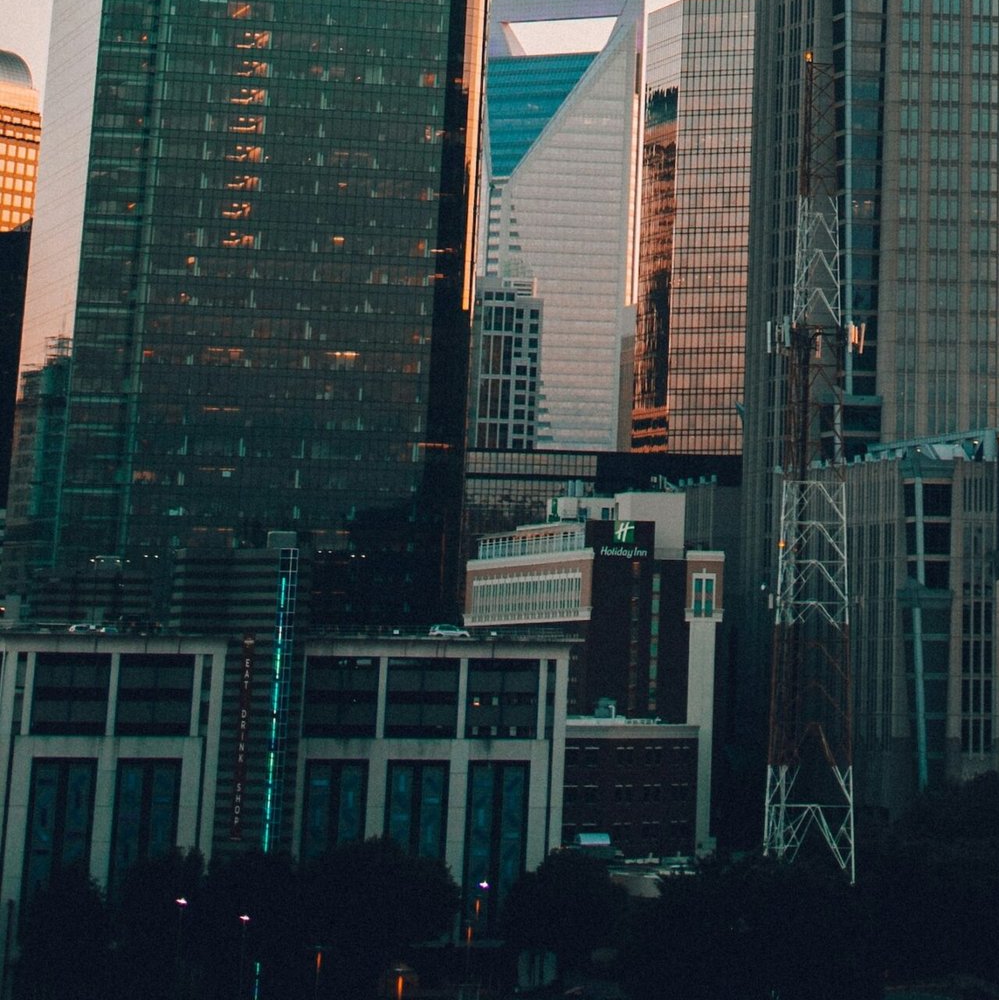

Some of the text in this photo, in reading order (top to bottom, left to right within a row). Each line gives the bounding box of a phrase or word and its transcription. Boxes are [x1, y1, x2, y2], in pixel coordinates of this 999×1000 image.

[615, 521, 635, 542] H
[600, 546, 648, 558] Holiday Inn
[238, 709, 247, 763] DRINK
